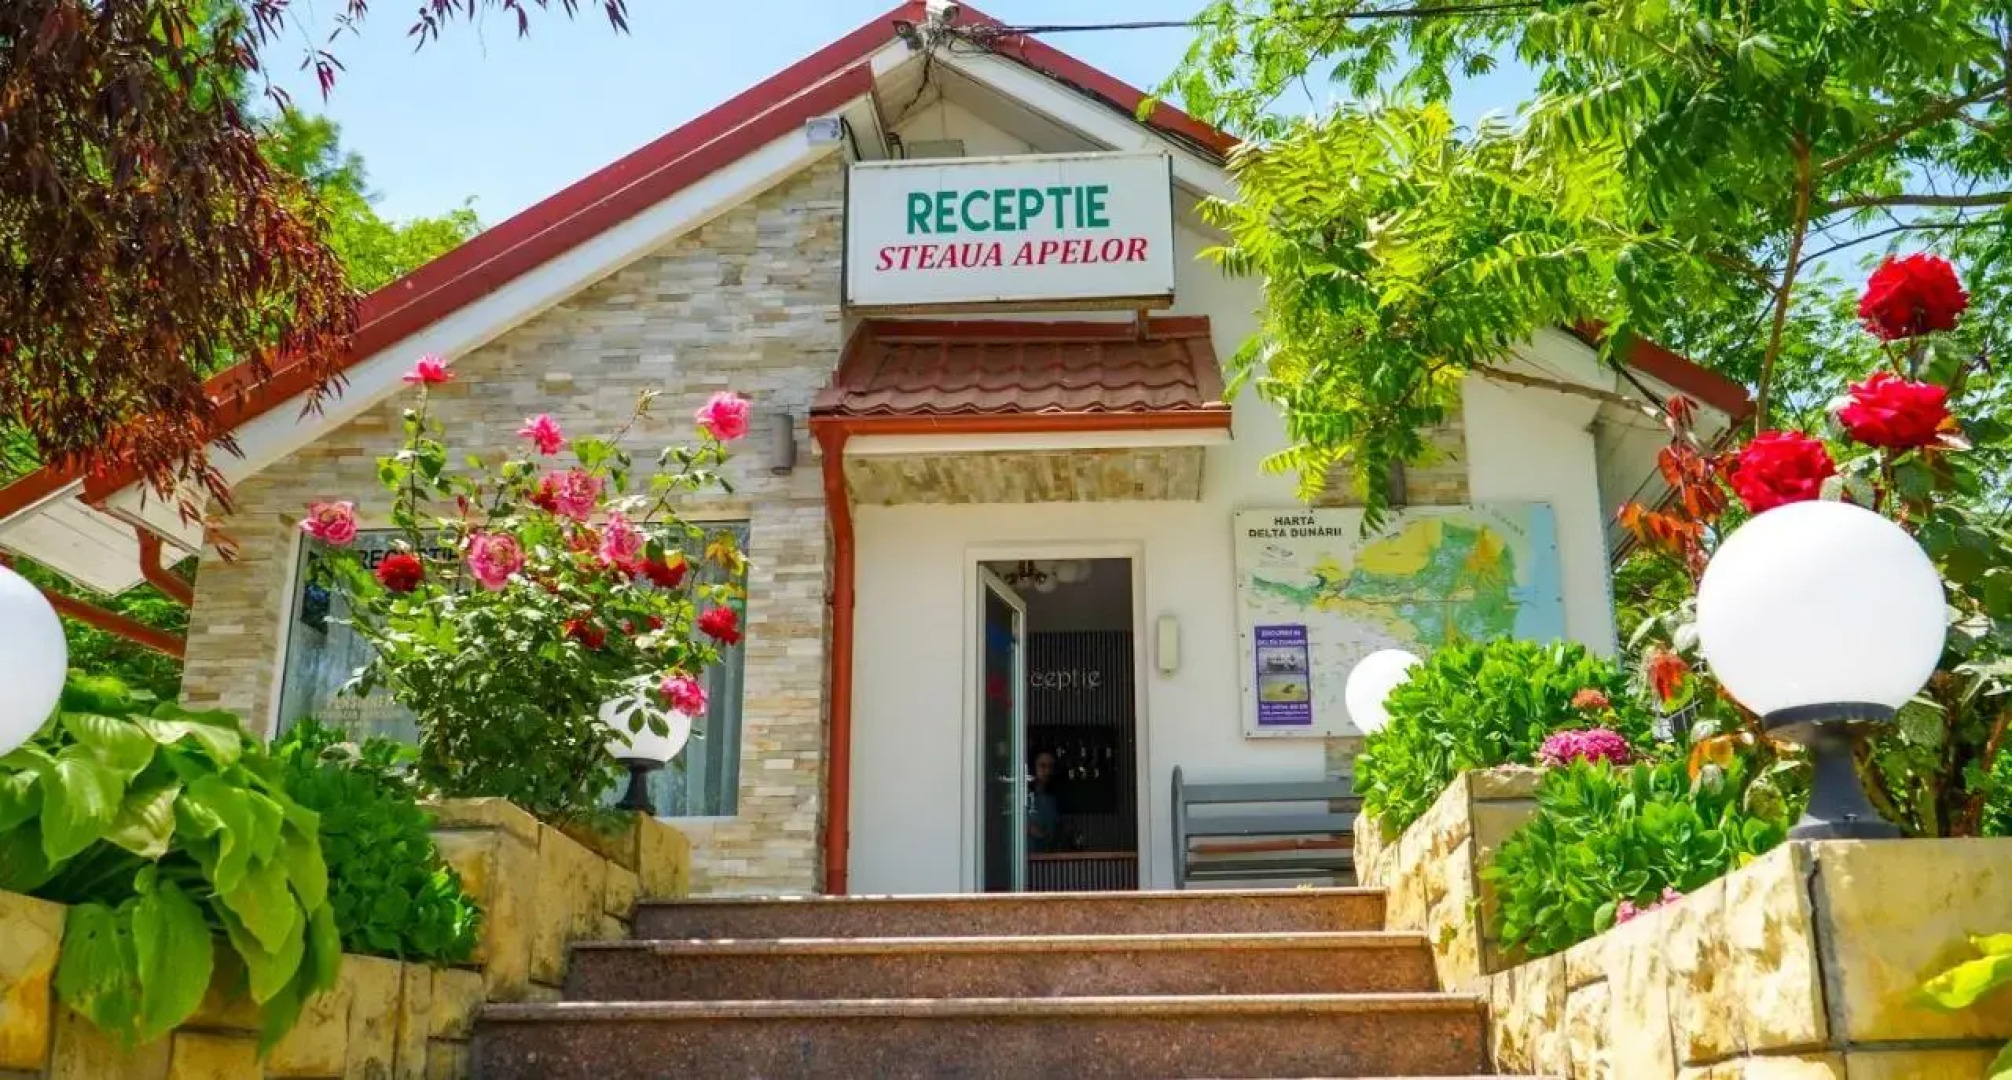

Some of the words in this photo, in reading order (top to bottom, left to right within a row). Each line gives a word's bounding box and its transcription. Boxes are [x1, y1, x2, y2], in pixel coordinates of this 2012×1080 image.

[907, 185, 1110, 235] RECEPTIE
[876, 241, 1002, 271] STEAUA
[1012, 237, 1148, 266] APELOR
[1249, 527, 1287, 538] DELTA
[1274, 516, 1315, 526] HARTA
[1030, 667, 1101, 691] ceptie
